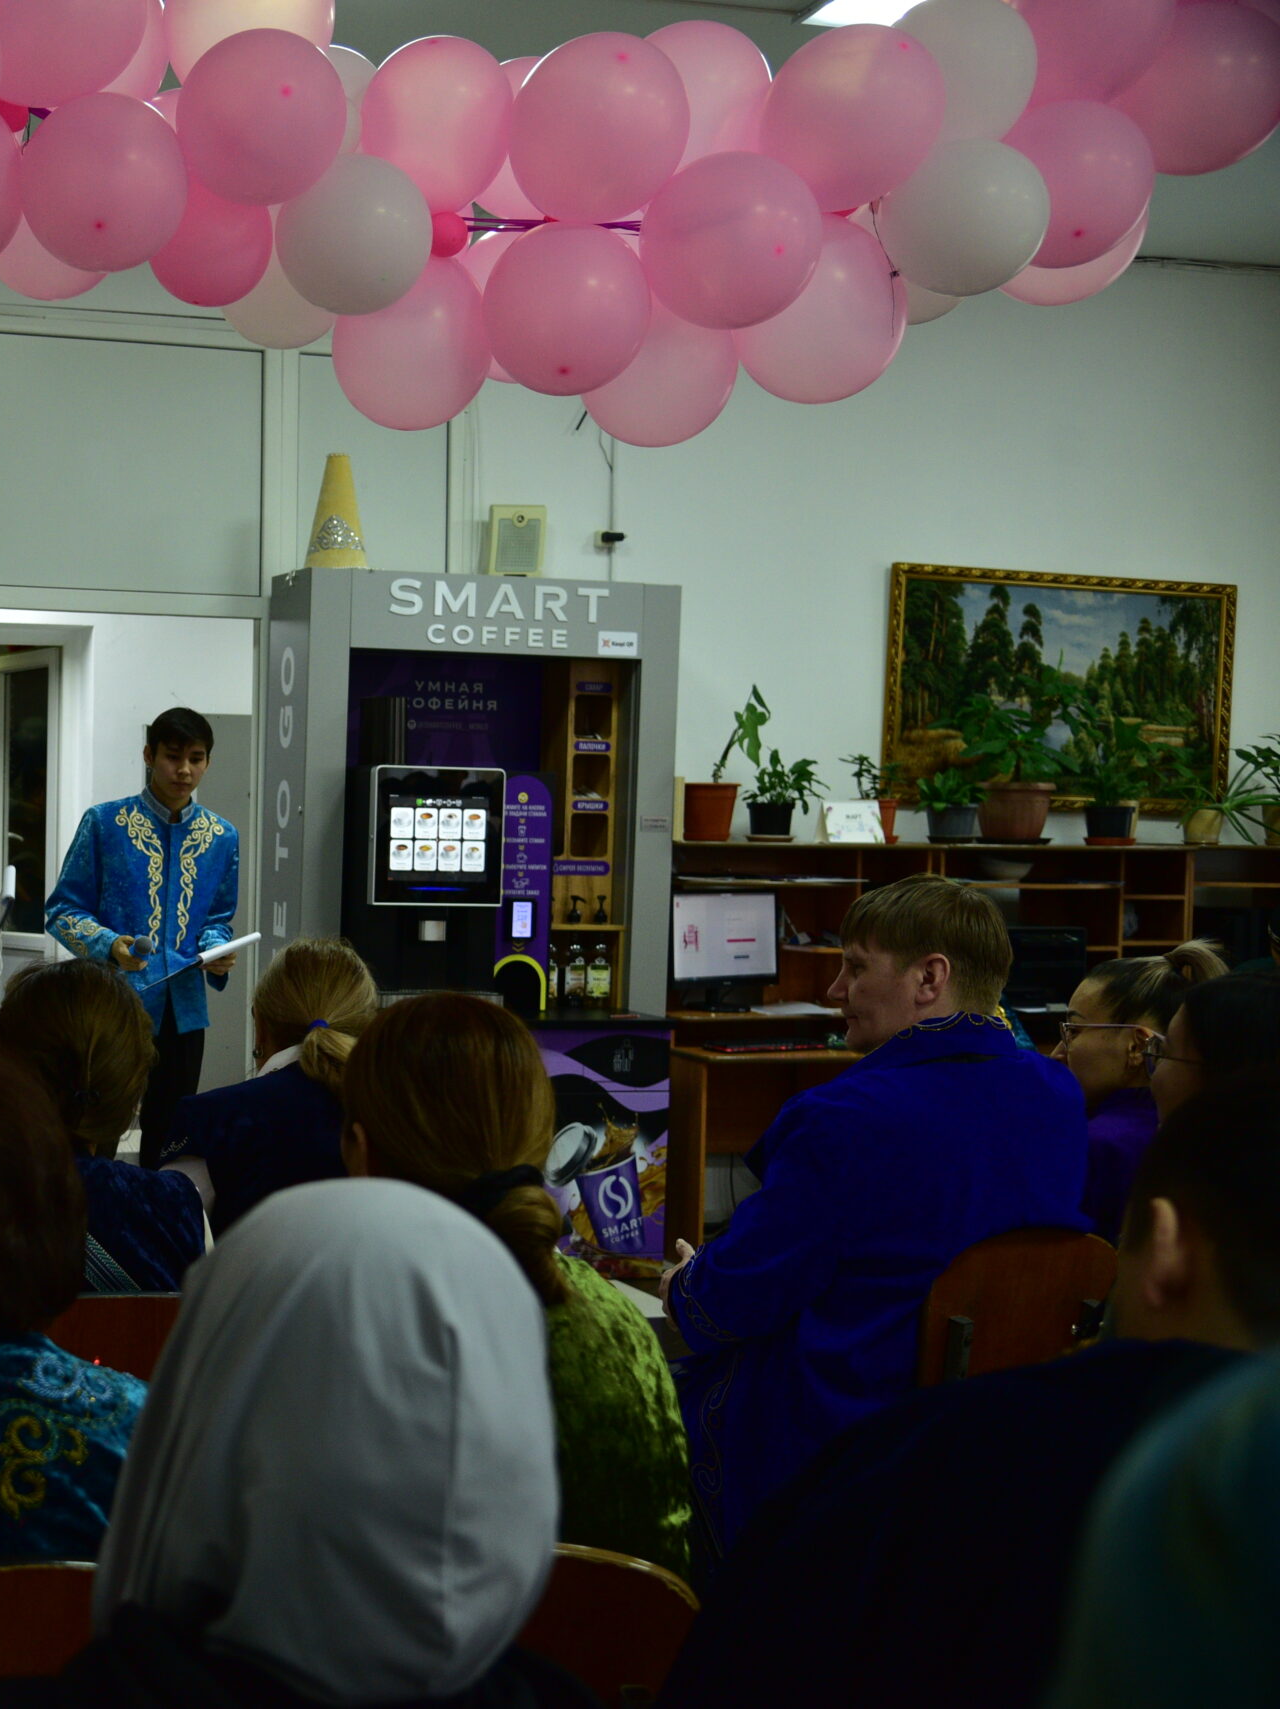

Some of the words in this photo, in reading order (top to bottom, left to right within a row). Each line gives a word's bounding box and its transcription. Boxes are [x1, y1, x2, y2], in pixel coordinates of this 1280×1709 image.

[388, 577, 610, 623] SMART
[426, 623, 569, 649] COFFEE
[279, 646, 295, 749] GO
[415, 680, 484, 694] УМНАЯ
[407, 695, 498, 711] ОФЕЙНЯ
[577, 801, 604, 809] КРЫШКИ
[275, 779, 291, 872] TO
[601, 1217, 643, 1239] SMART
